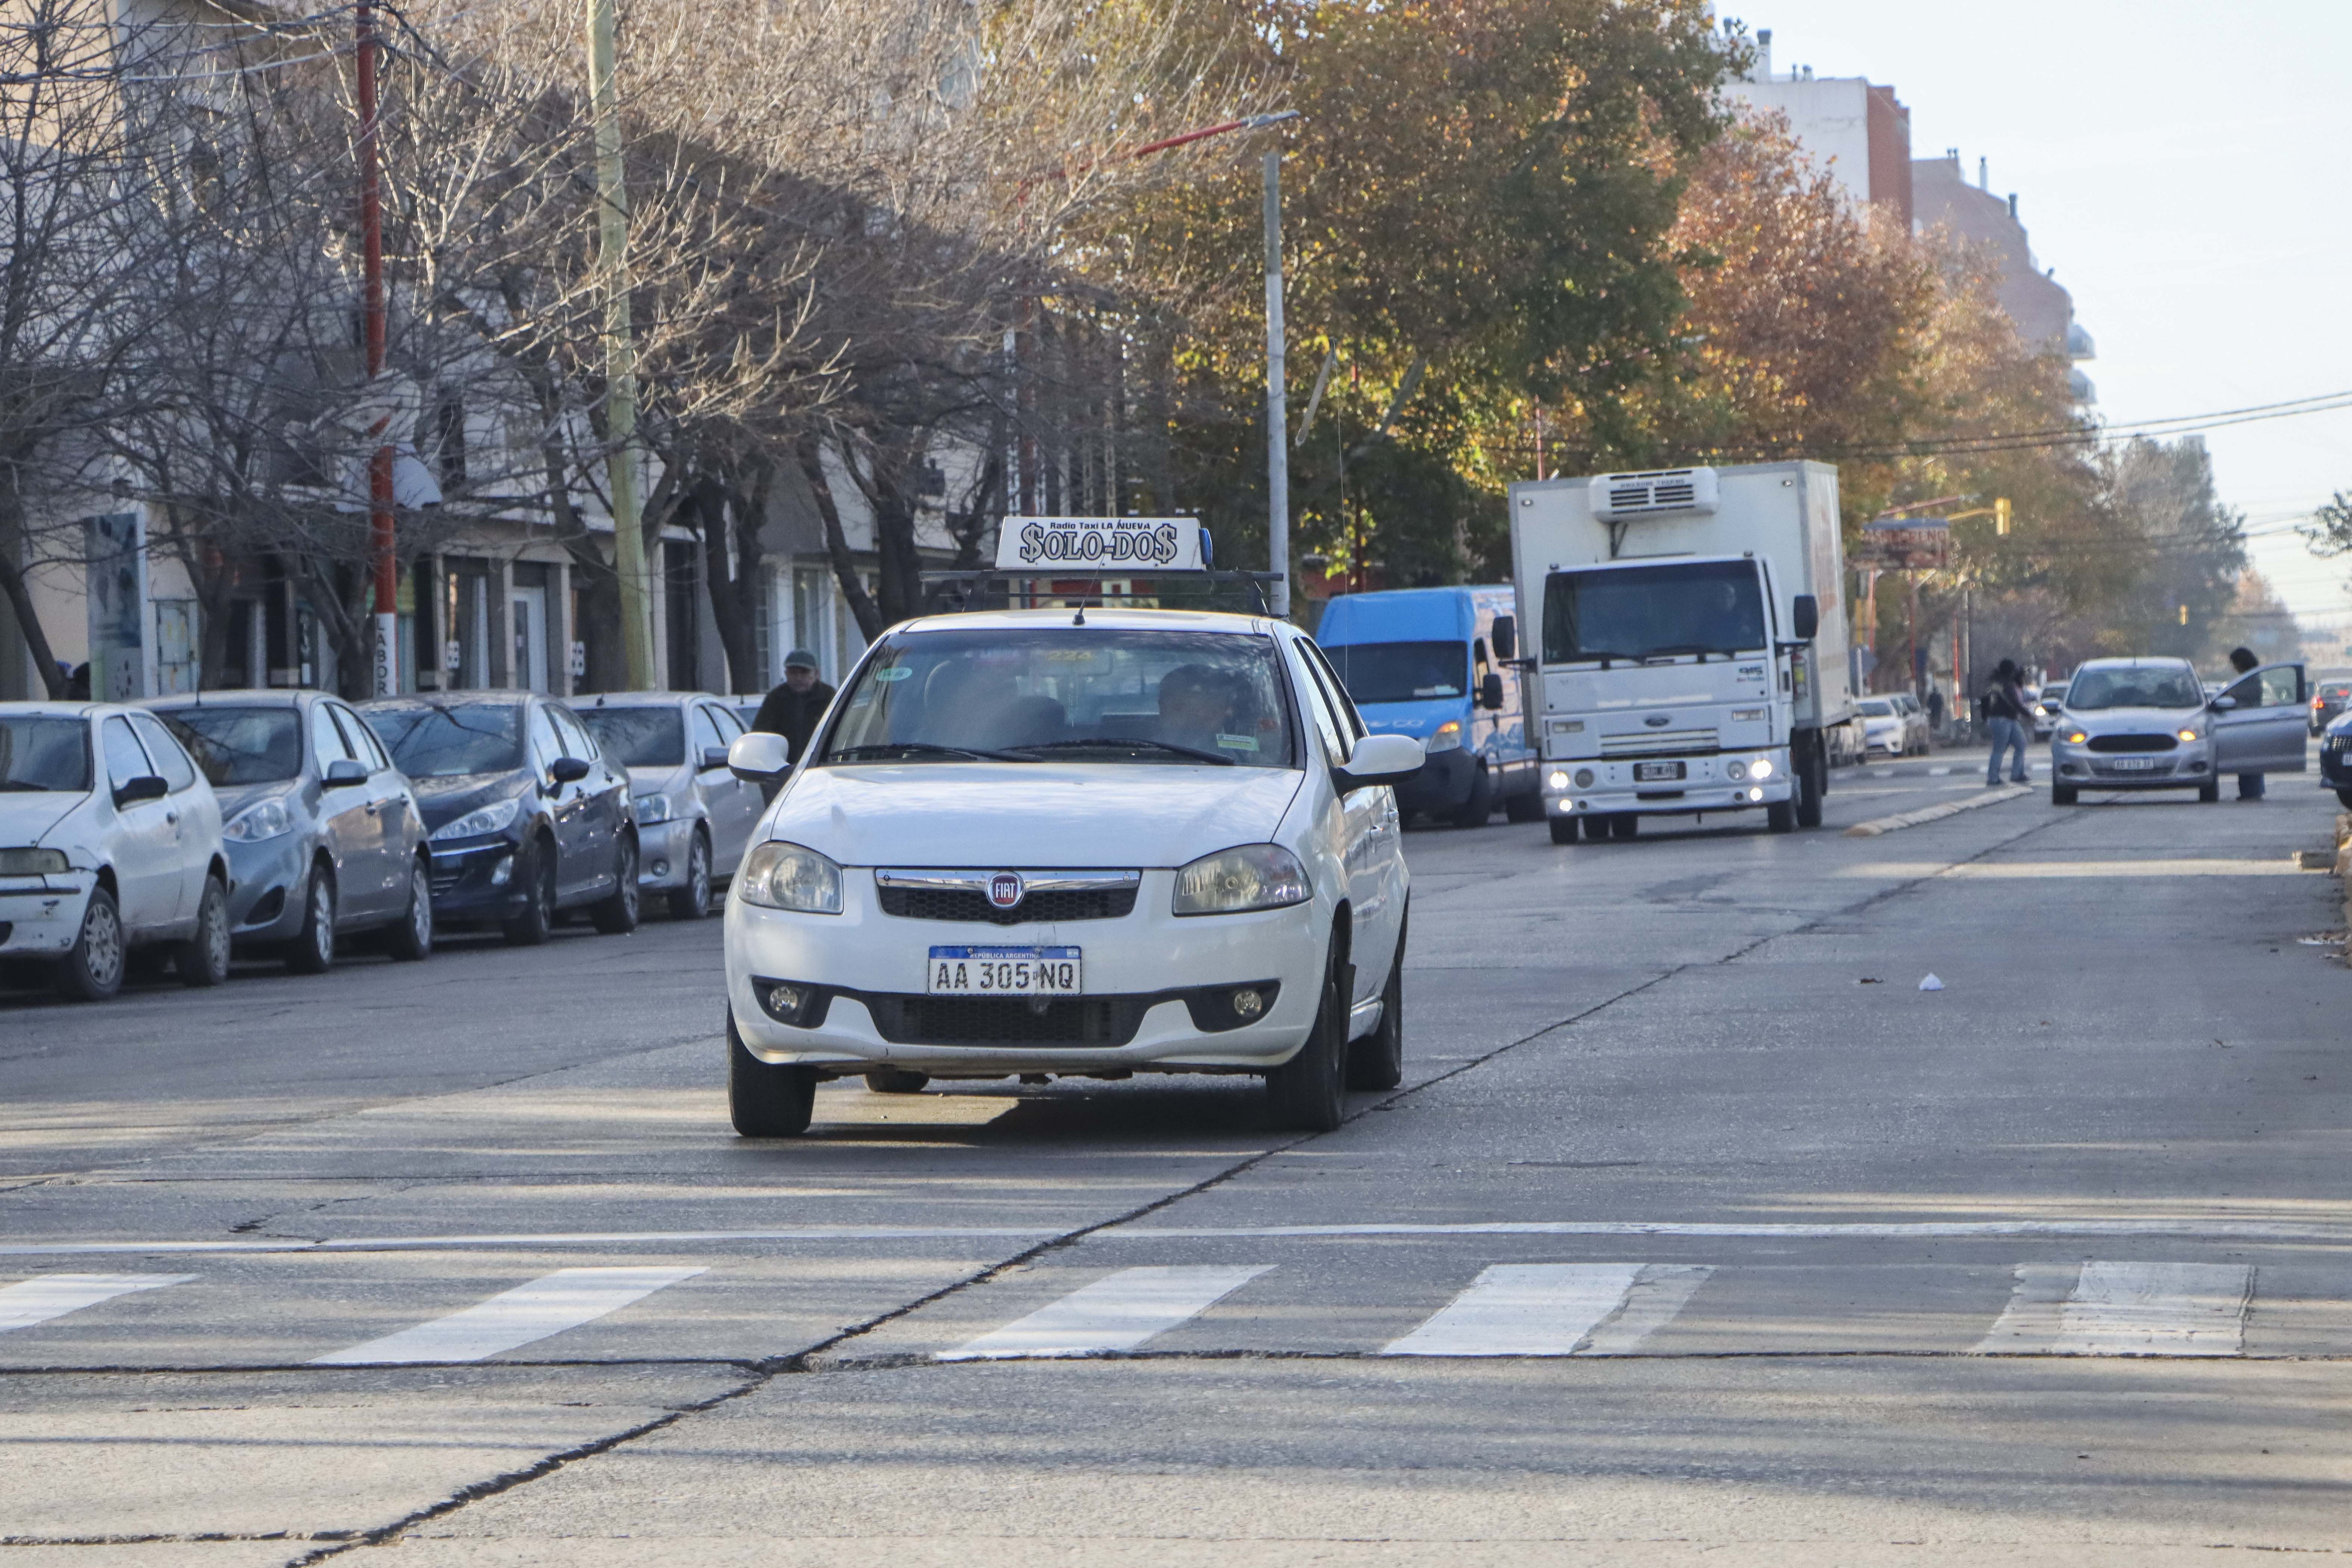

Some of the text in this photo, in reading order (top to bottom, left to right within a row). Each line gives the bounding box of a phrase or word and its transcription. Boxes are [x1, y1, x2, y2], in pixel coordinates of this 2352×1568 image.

[376, 617, 388, 695] LABOR
[996, 882, 1016, 899] FIAT
[936, 963, 968, 989] AA
[980, 963, 1029, 989] 305
[1040, 963, 1073, 989] NQ
